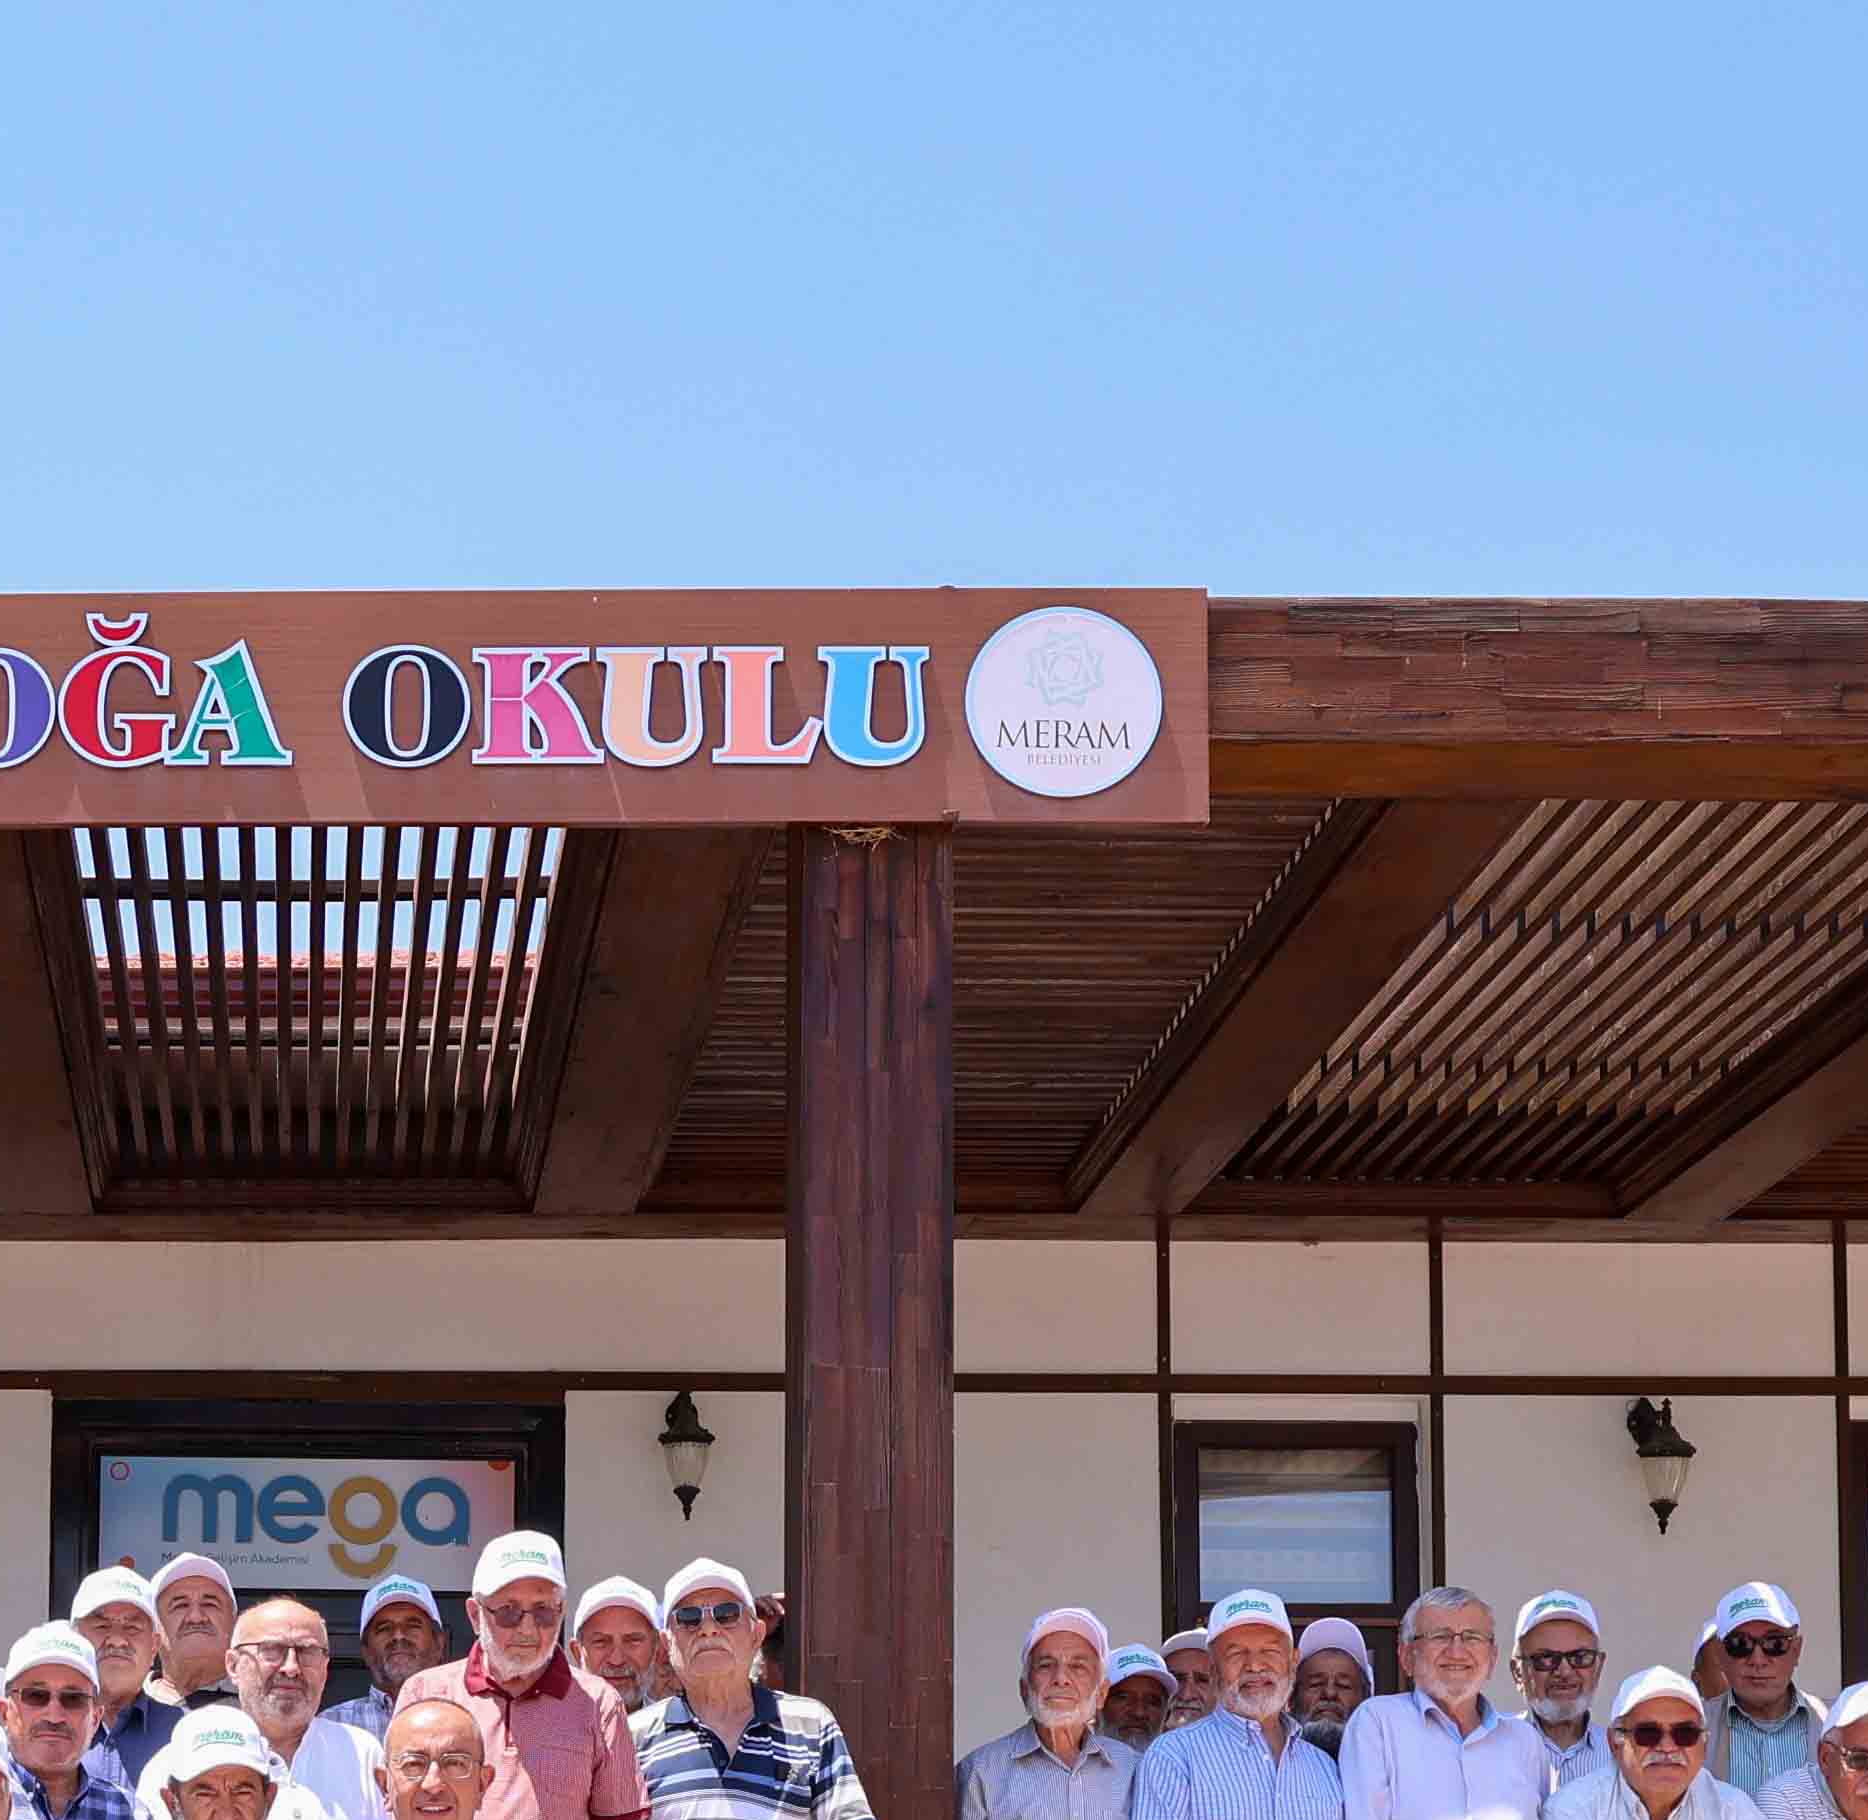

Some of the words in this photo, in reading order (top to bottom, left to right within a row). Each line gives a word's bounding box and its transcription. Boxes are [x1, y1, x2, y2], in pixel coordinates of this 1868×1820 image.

[343, 644, 930, 768] OKULU
[997, 719, 1131, 750] MERAM
[161, 1474, 472, 1579] mega
